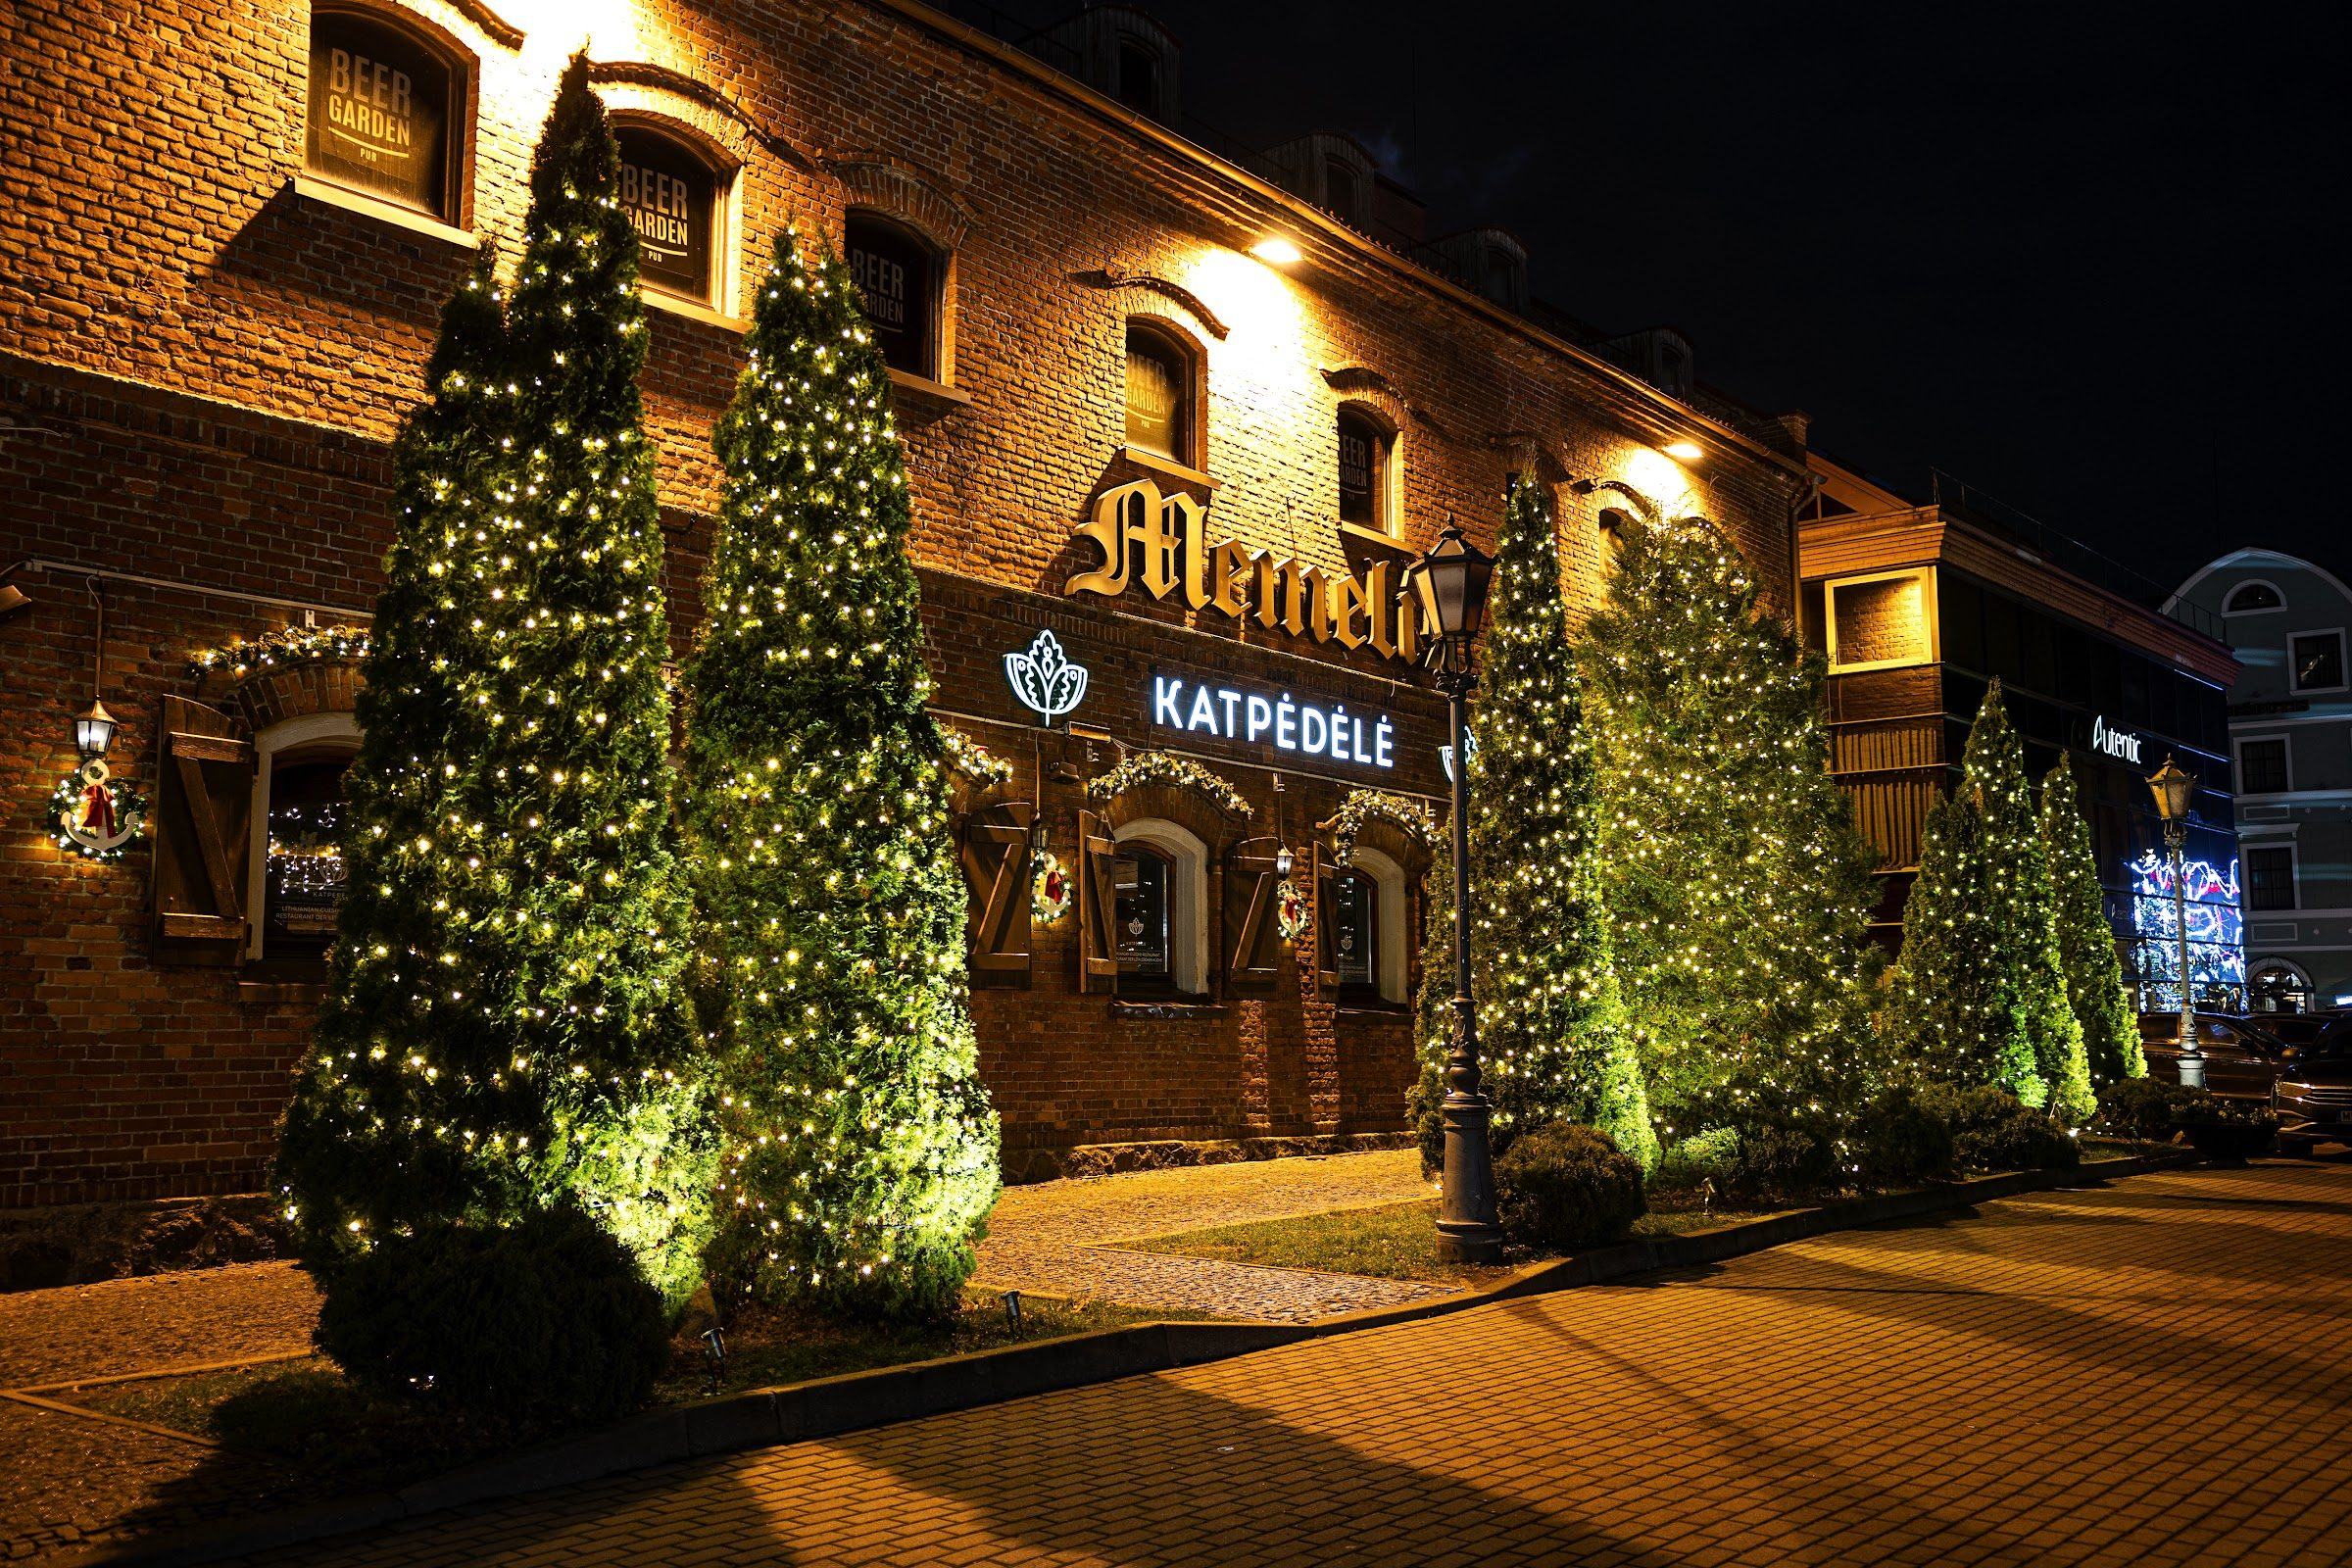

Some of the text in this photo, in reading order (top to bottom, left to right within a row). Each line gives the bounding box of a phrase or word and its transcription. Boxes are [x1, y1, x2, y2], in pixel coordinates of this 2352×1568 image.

[330, 47, 412, 118] BEER
[328, 94, 410, 147] GARDEN
[360, 147, 377, 163] PUB
[622, 163, 688, 220] BEER
[648, 250, 662, 263] PUB
[853, 247, 904, 301] BEER
[870, 292, 904, 323] RDEN
[1126, 351, 1166, 394] BEER
[1126, 384, 1165, 415] GARDEN
[1342, 434, 1366, 469] EER
[1340, 464, 1367, 487] ARDEN
[1063, 478, 1421, 666] Memeli
[1154, 676, 1395, 768] KATPĖDĖLĖ
[2092, 714, 2141, 764] Autentic
